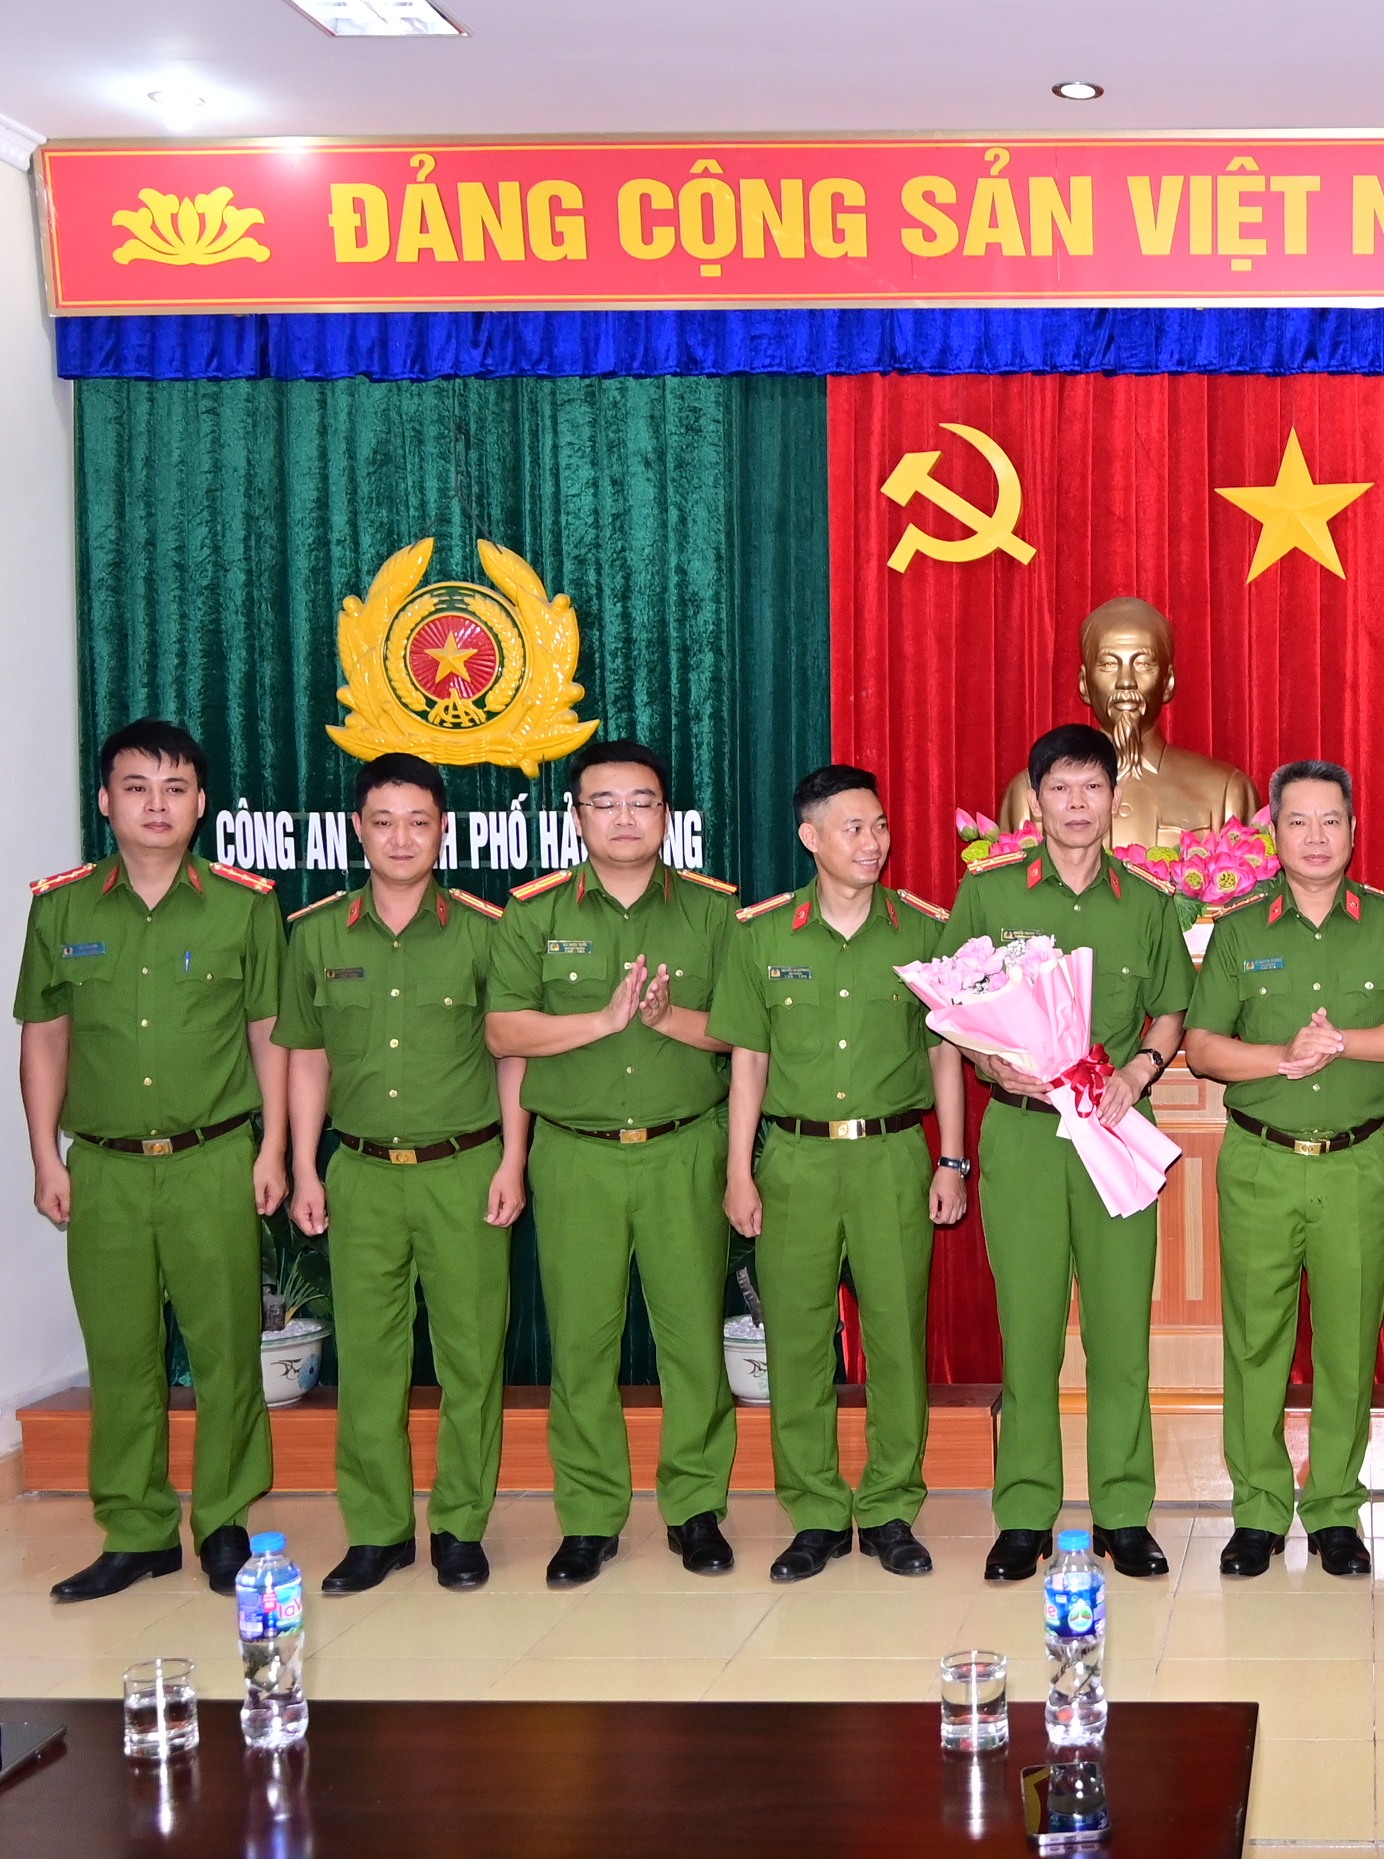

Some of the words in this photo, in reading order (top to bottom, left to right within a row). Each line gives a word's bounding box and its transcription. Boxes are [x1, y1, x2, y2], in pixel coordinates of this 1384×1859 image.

[328, 153, 588, 262] ĐẢNG
[618, 159, 868, 277] CỘNG
[901, 148, 1094, 257] SẢN
[1127, 157, 1321, 271] VIỆT
[215, 797, 296, 870] CÔNG
[306, 812, 348, 870] AN
[469, 793, 528, 870] PHỐ
[538, 791, 588, 869] HẢ
